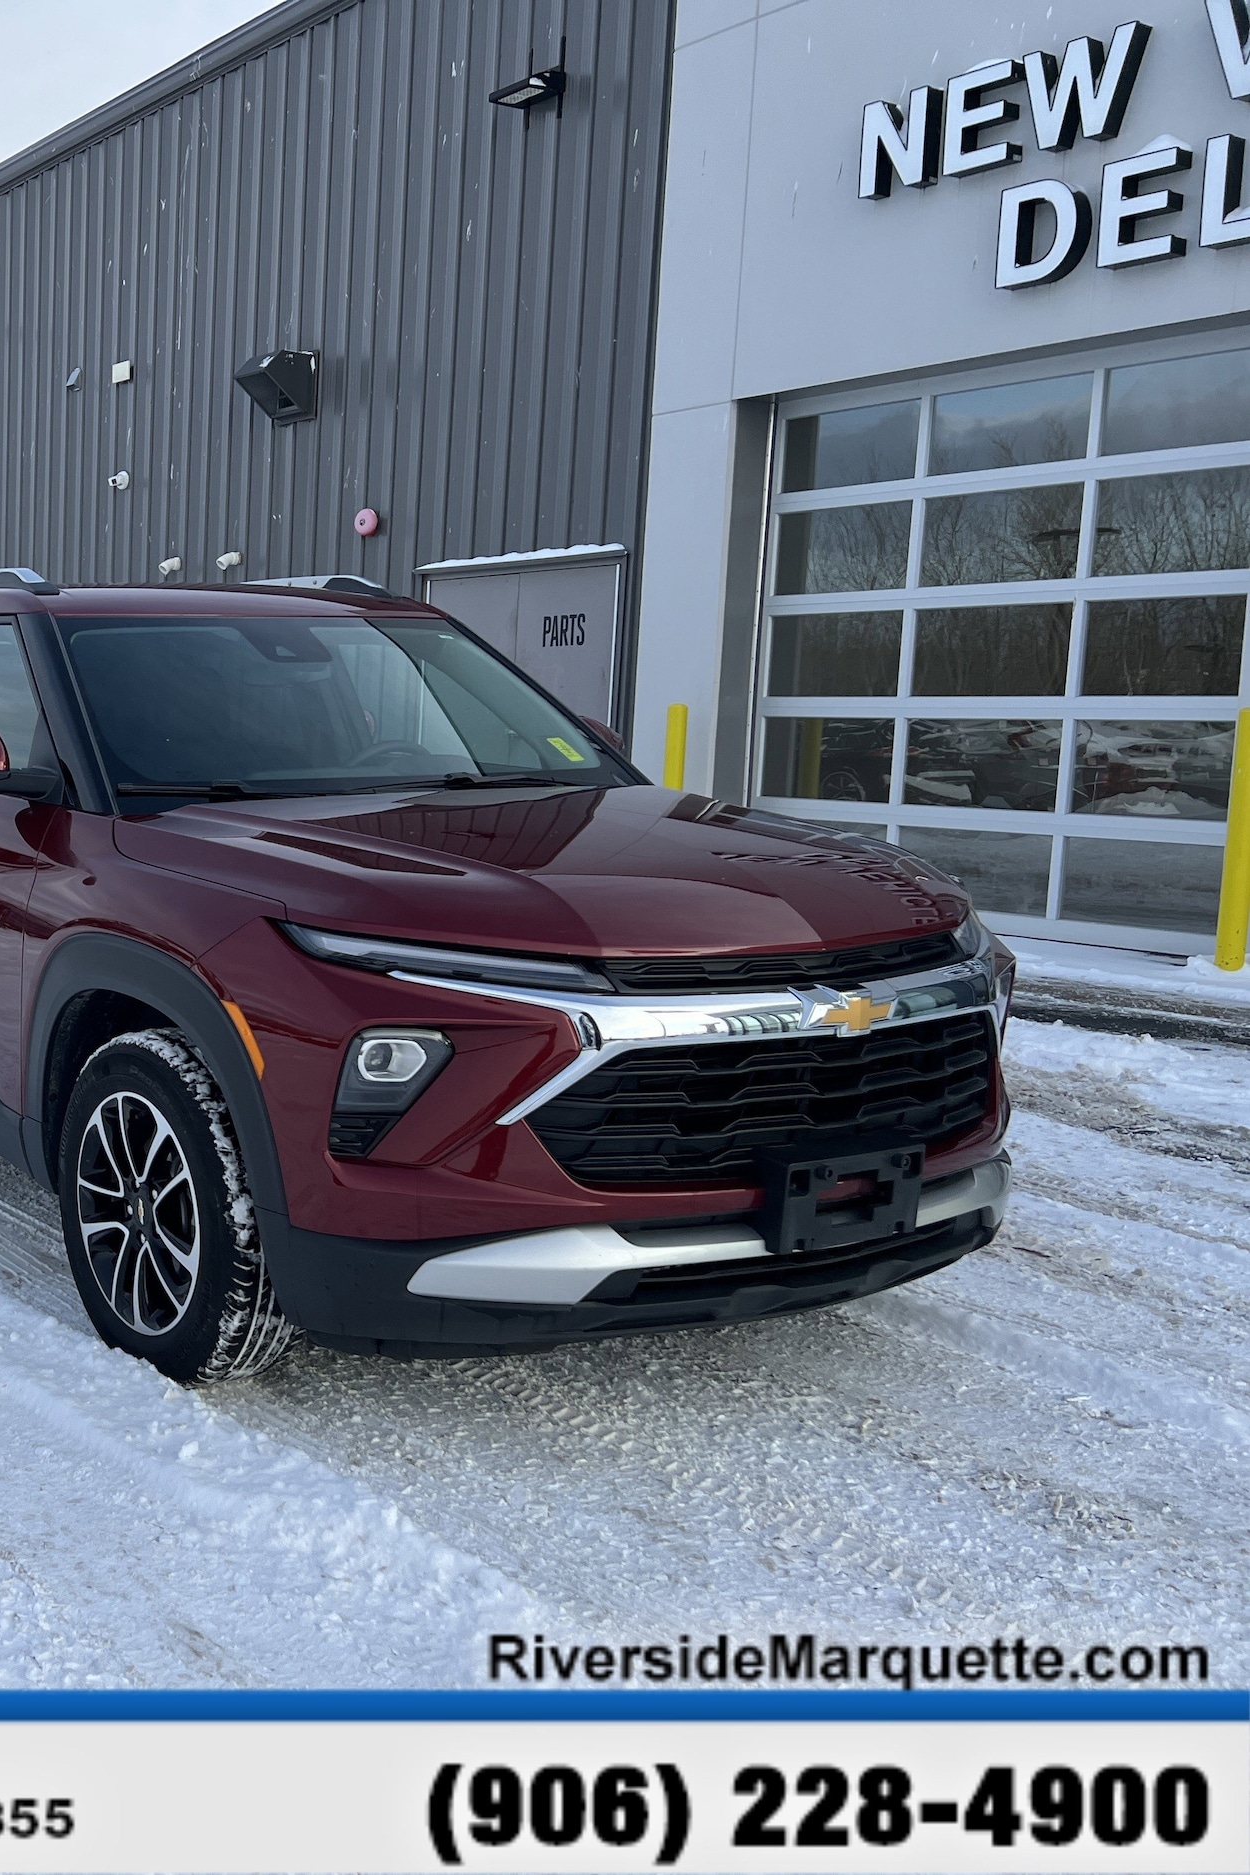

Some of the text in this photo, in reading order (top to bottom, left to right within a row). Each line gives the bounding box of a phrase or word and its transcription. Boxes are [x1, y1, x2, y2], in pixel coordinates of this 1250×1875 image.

[857, 20, 1153, 200] NEW
[995, 133, 1250, 291] DEL
[542, 613, 586, 648] PARTS
